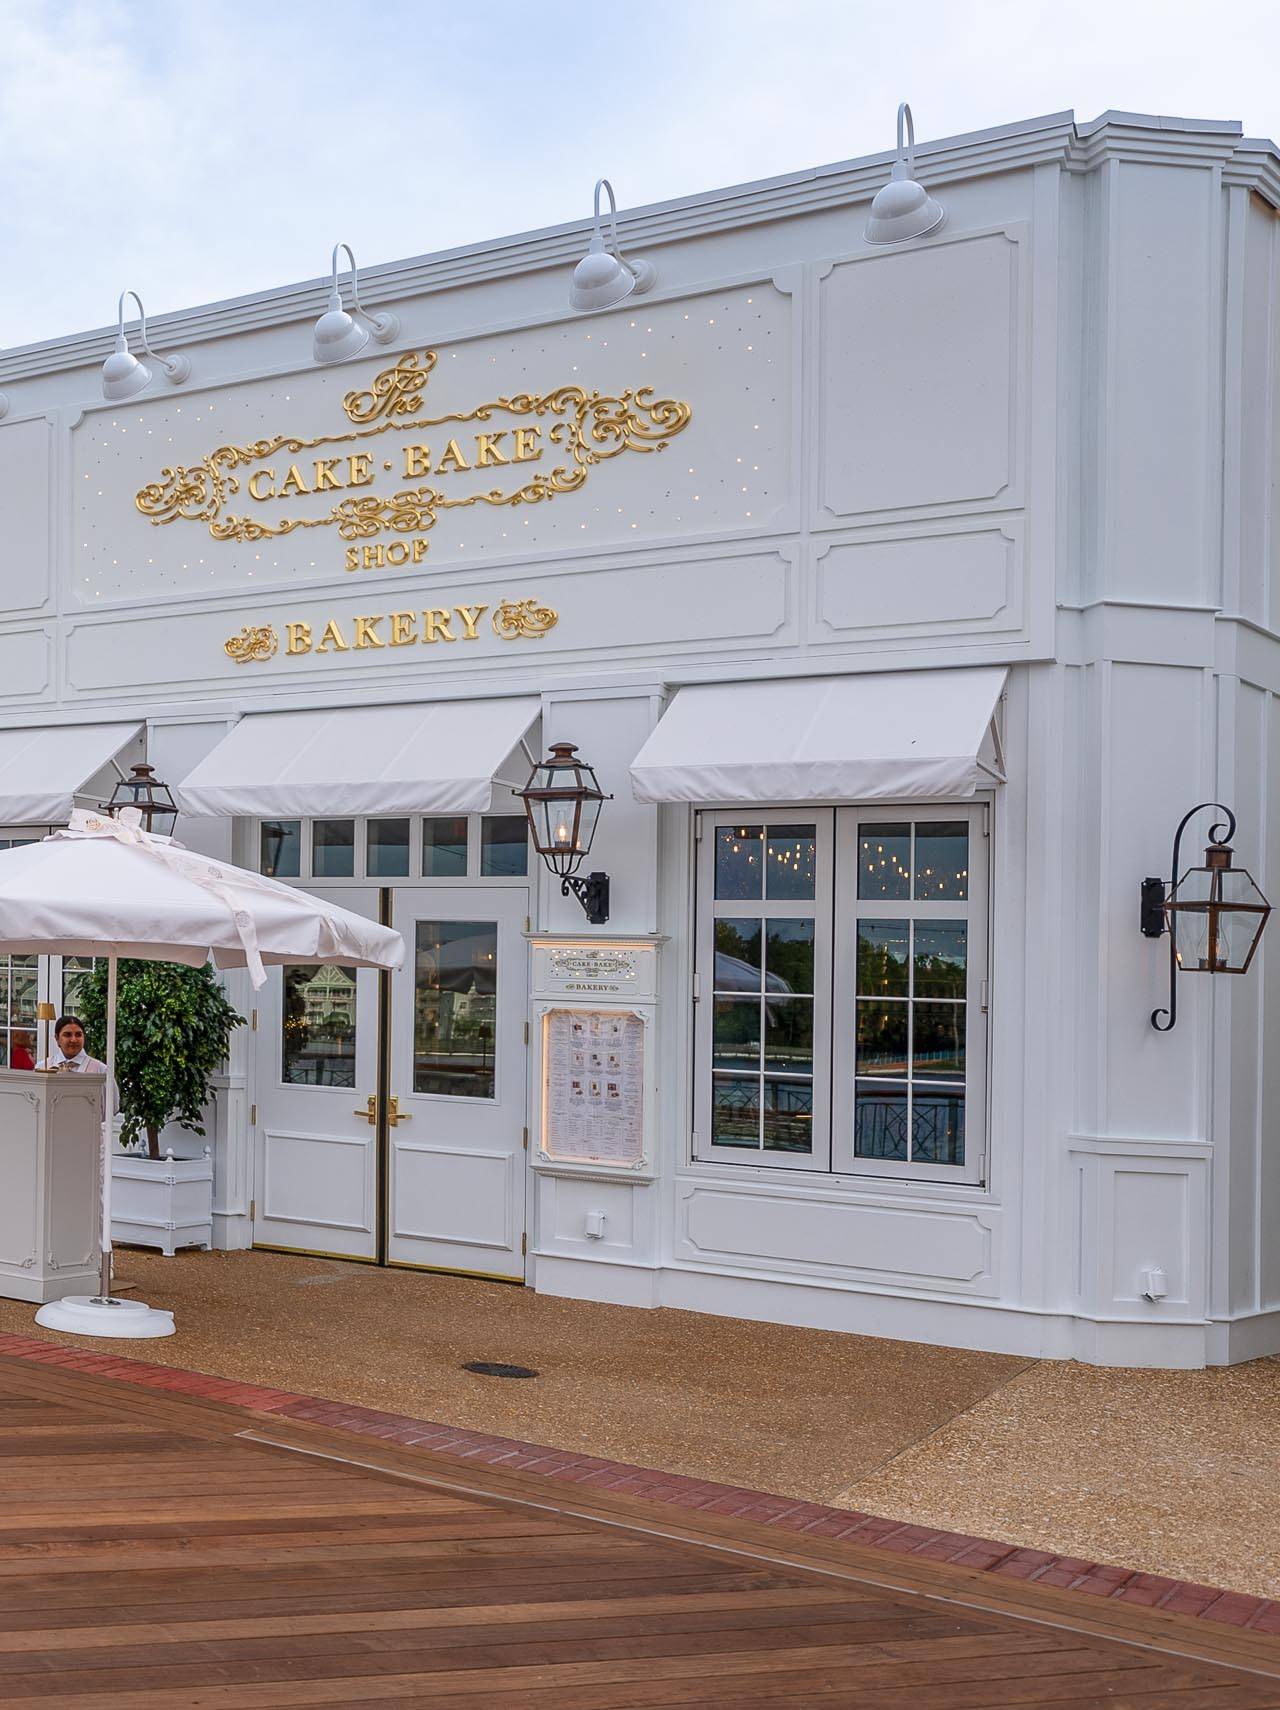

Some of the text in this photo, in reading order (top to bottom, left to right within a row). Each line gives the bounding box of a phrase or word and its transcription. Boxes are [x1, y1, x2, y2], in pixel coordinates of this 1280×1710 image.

[344, 350, 437, 423] The
[248, 425, 545, 501] CAKE BAKE
[344, 538, 429, 571] SHOP
[285, 605, 490, 655] BAKERY
[576, 983, 609, 991] BAKERY
